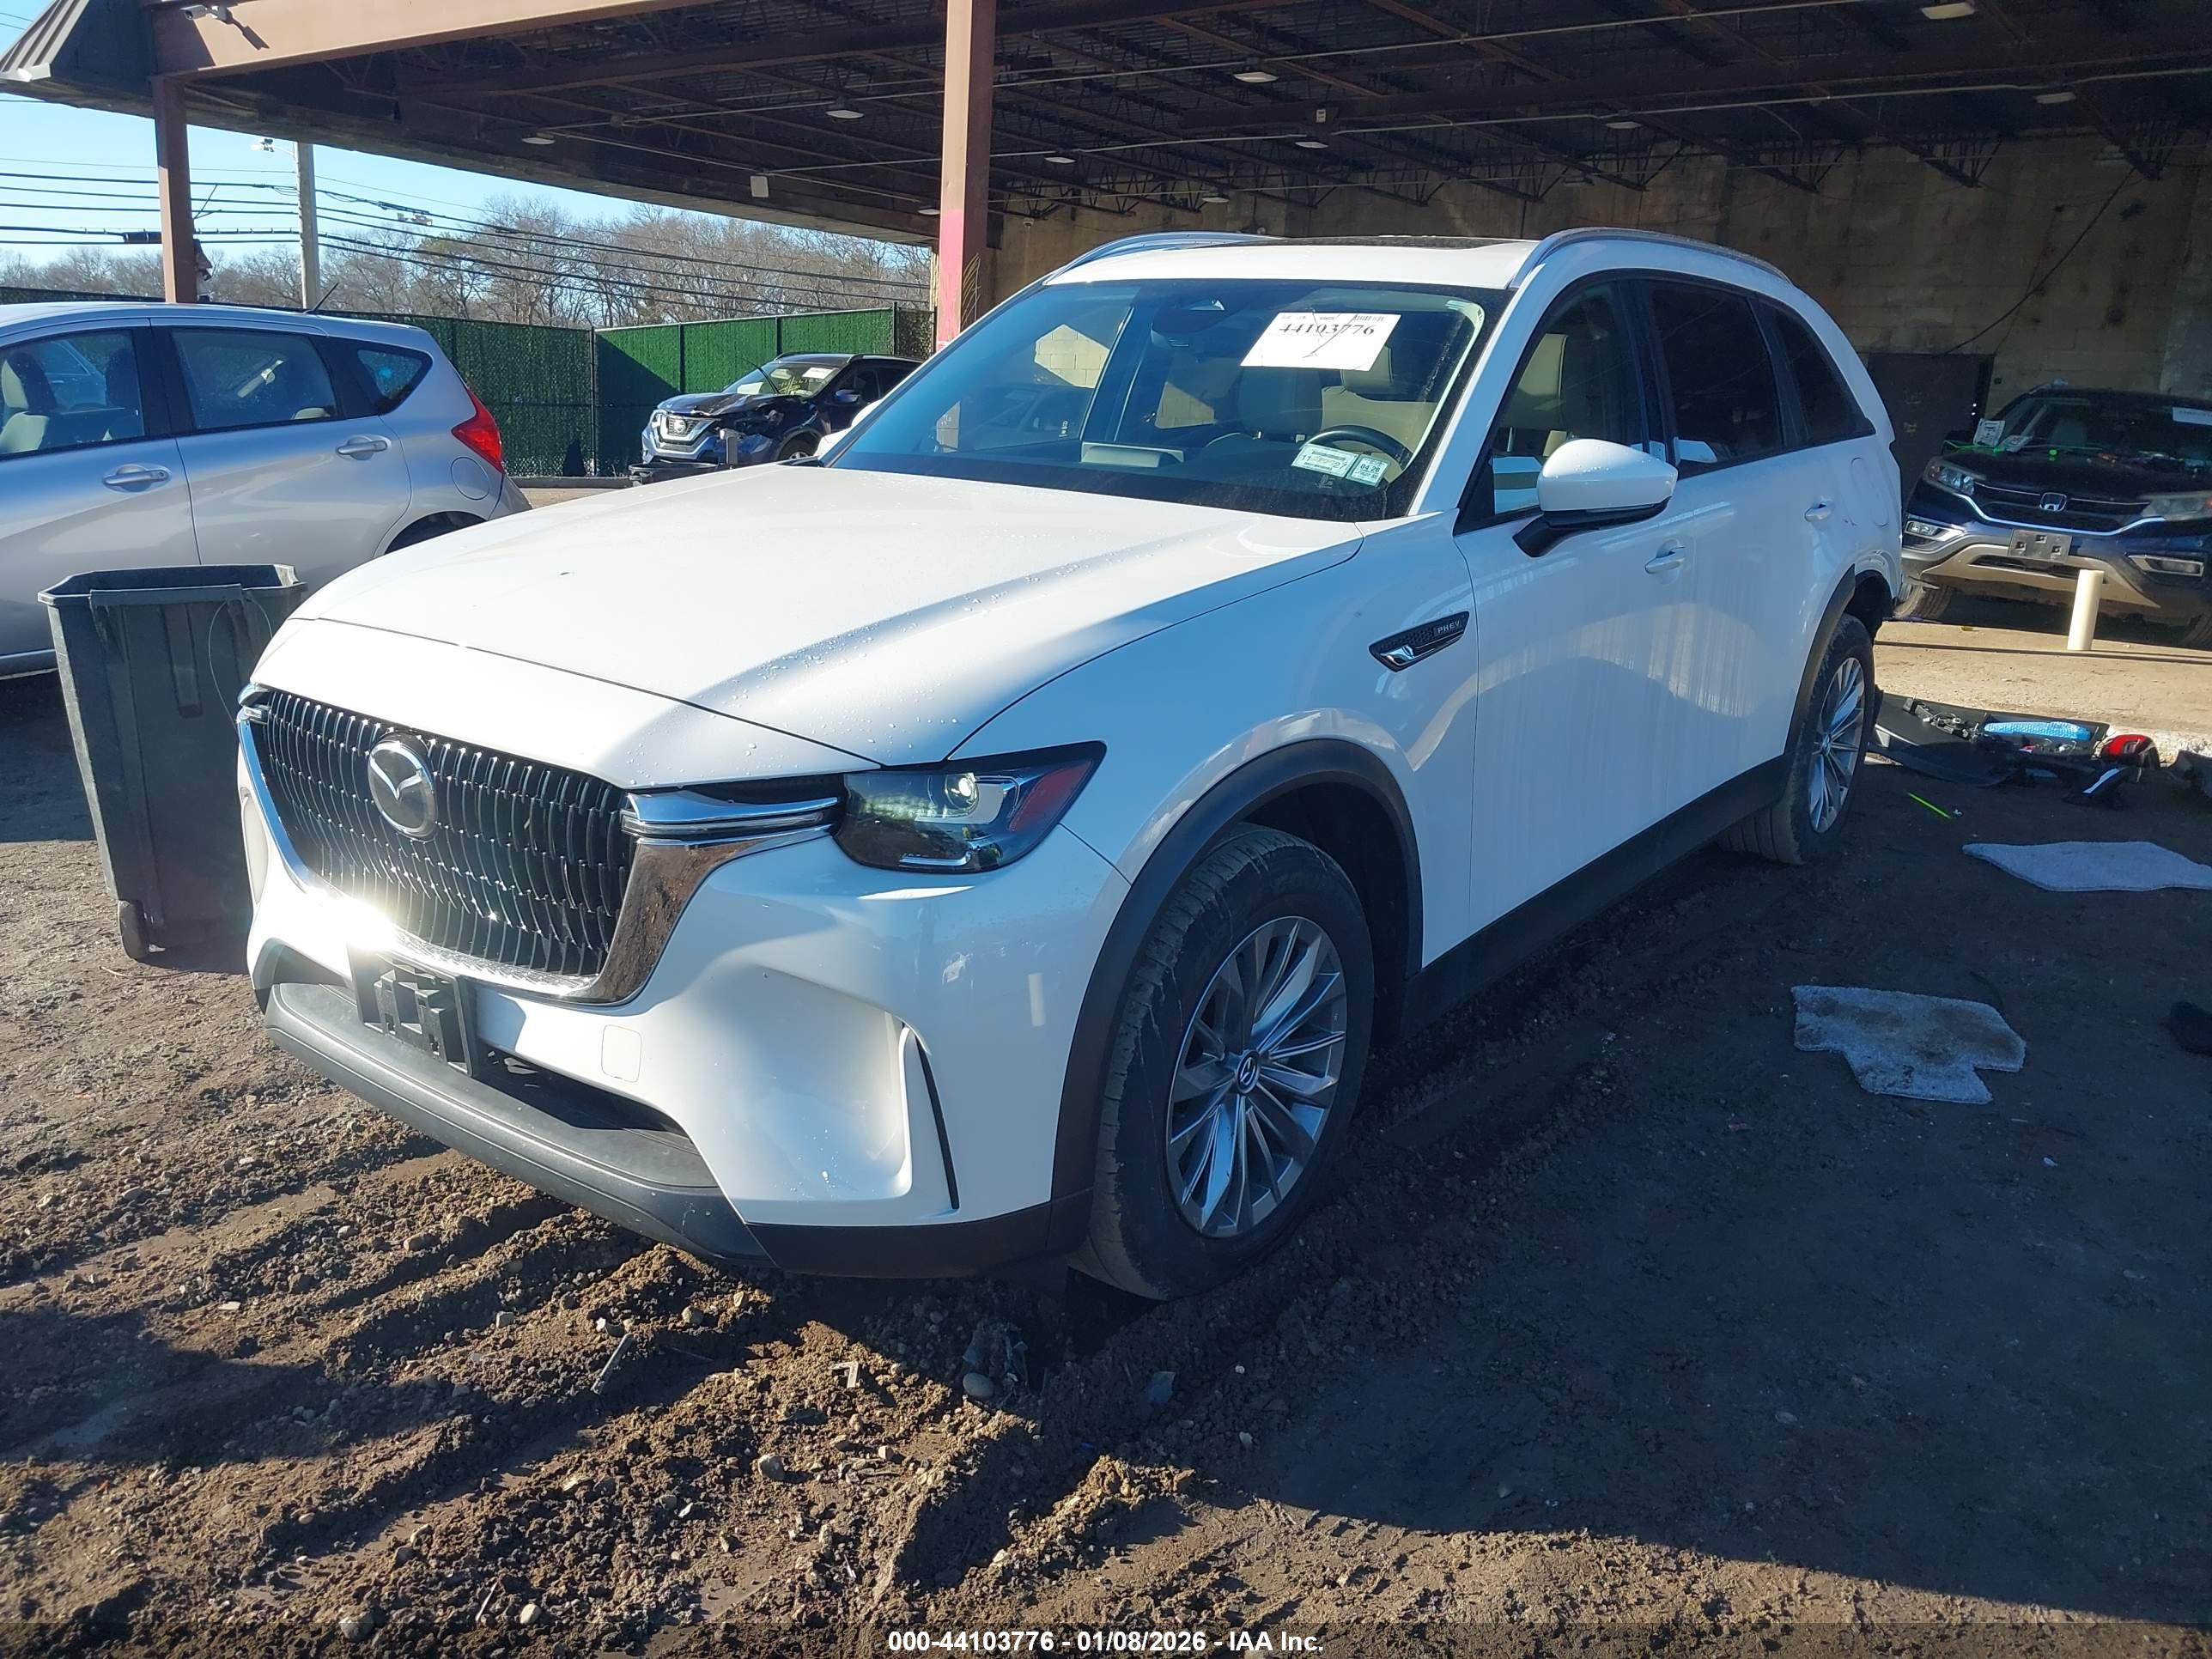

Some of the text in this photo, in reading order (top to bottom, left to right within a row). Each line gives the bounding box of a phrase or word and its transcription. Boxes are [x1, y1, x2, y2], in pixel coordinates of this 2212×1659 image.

[1279, 323, 1376, 336] 44103776
[1333, 460, 1347, 471] 27
[1437, 620, 1460, 634] PHEV
